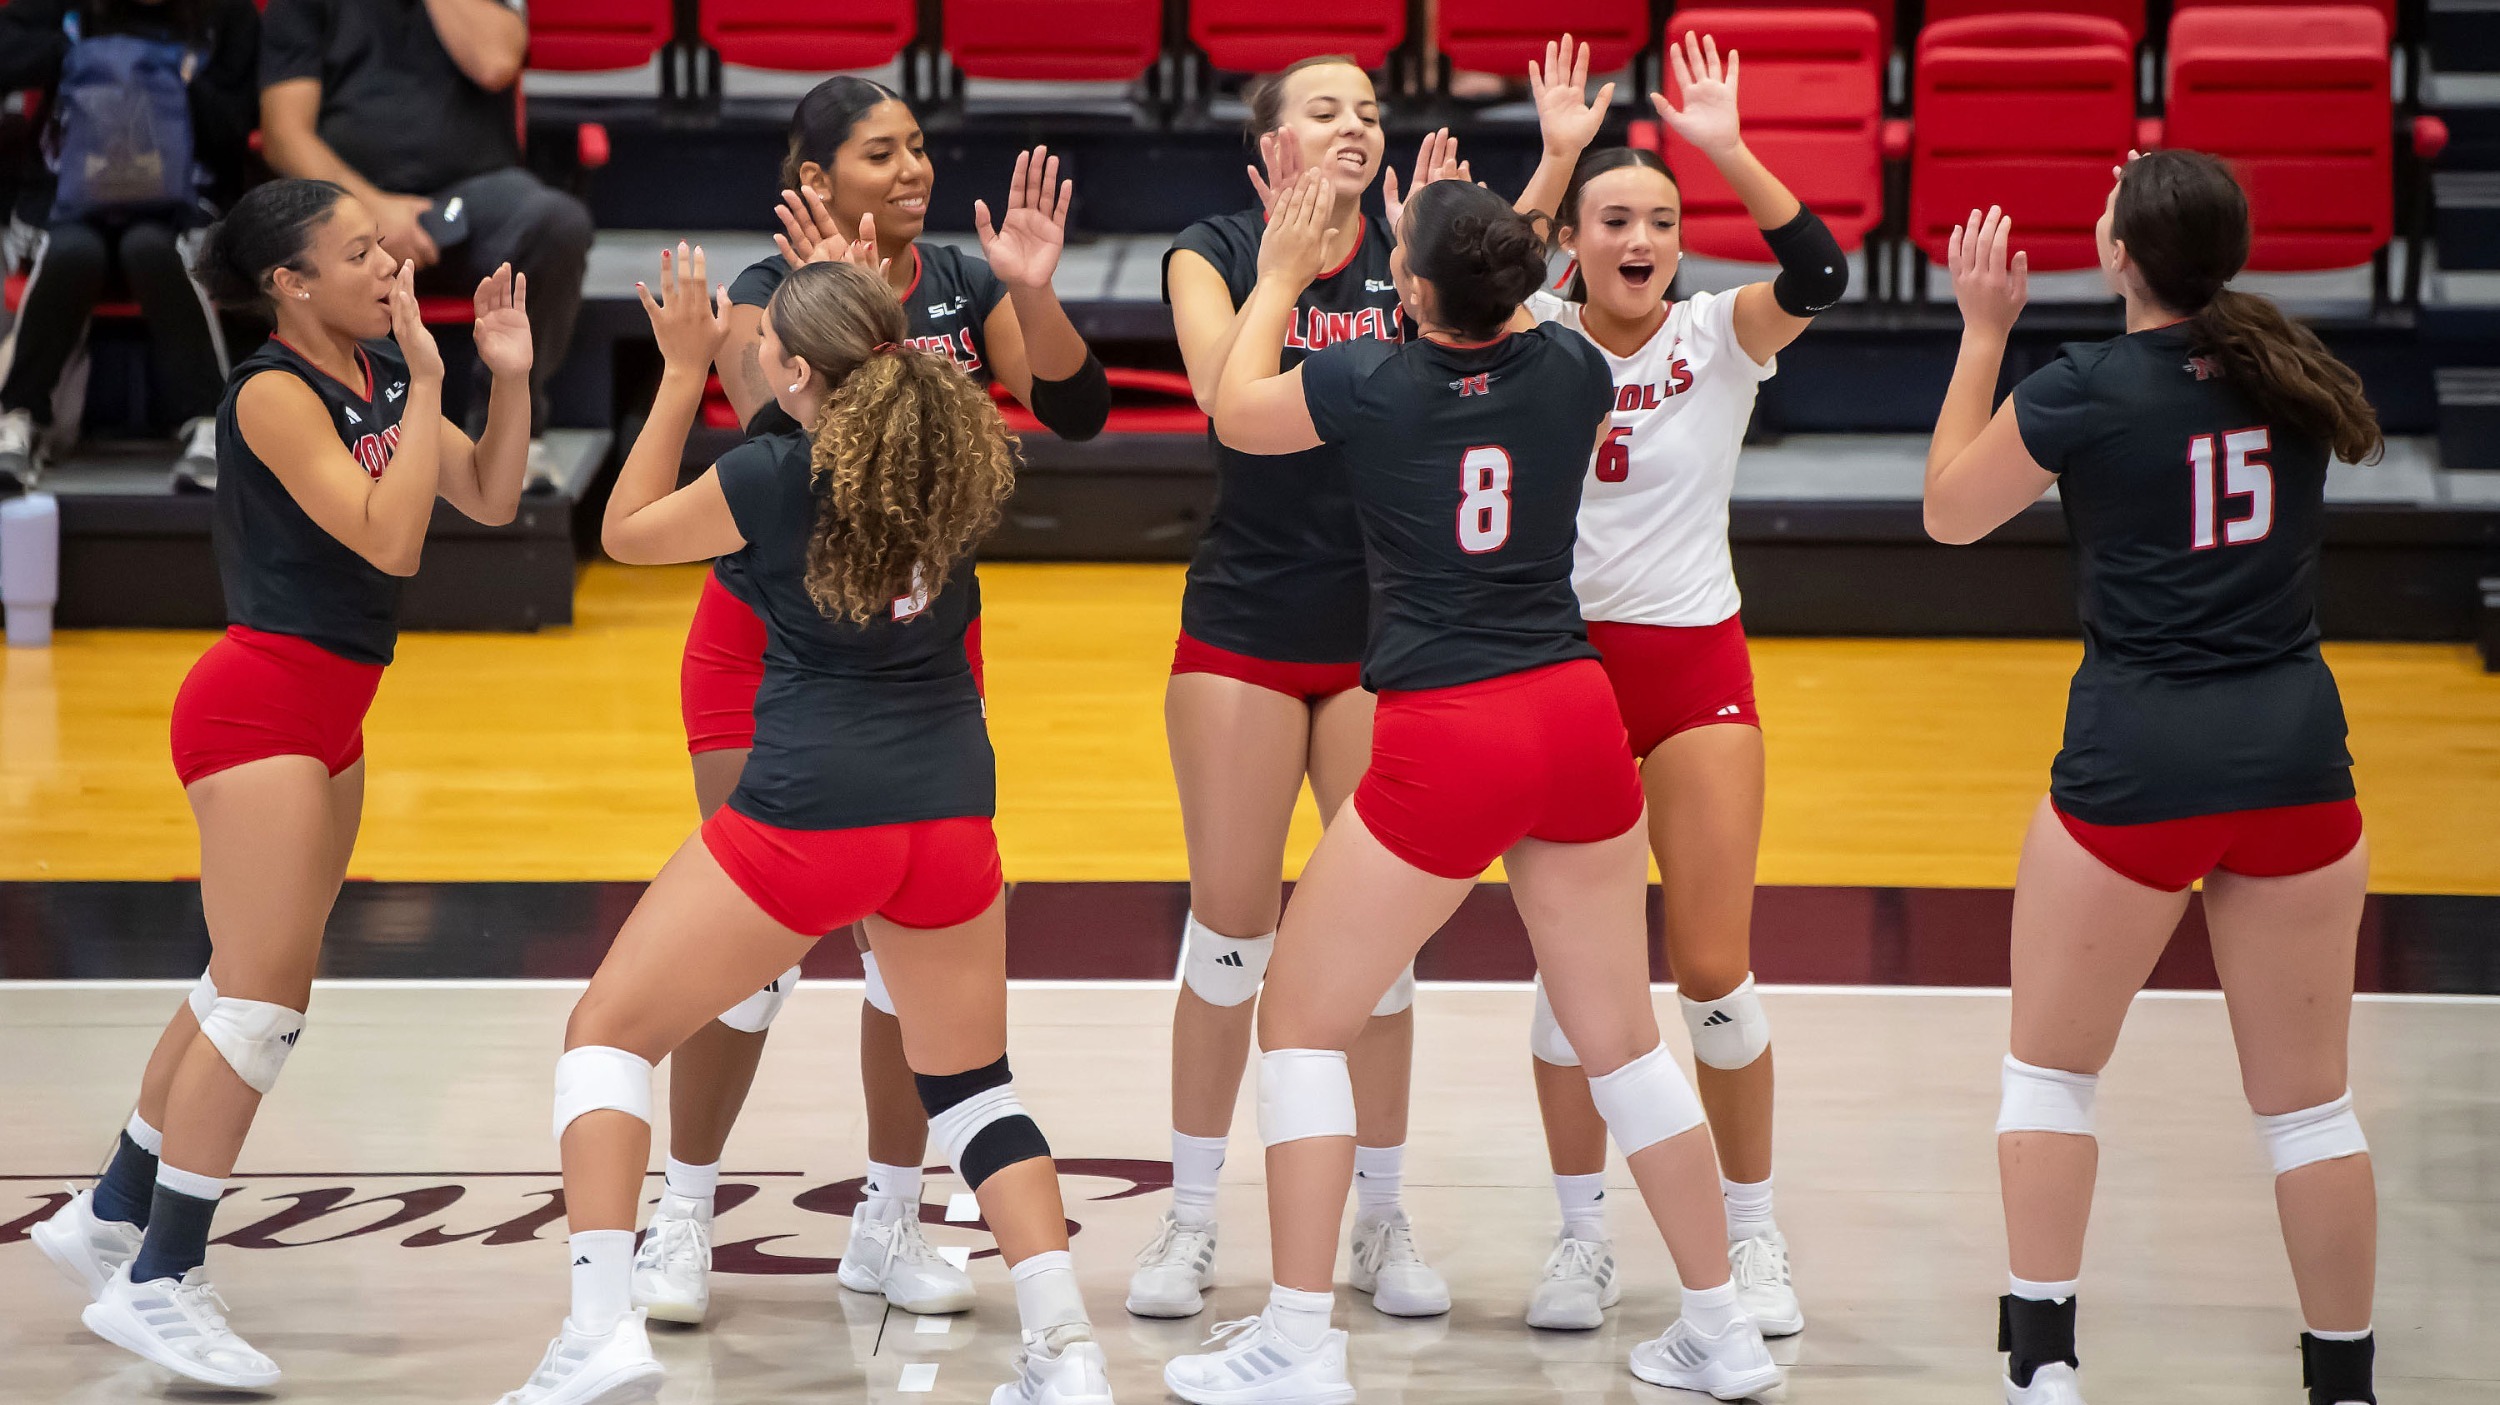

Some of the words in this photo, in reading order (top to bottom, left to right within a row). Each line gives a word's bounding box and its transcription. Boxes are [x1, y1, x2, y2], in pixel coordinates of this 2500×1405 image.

[1456, 444, 1514, 555] 8
[1595, 426, 1634, 483] 6
[2186, 424, 2276, 551] 15
